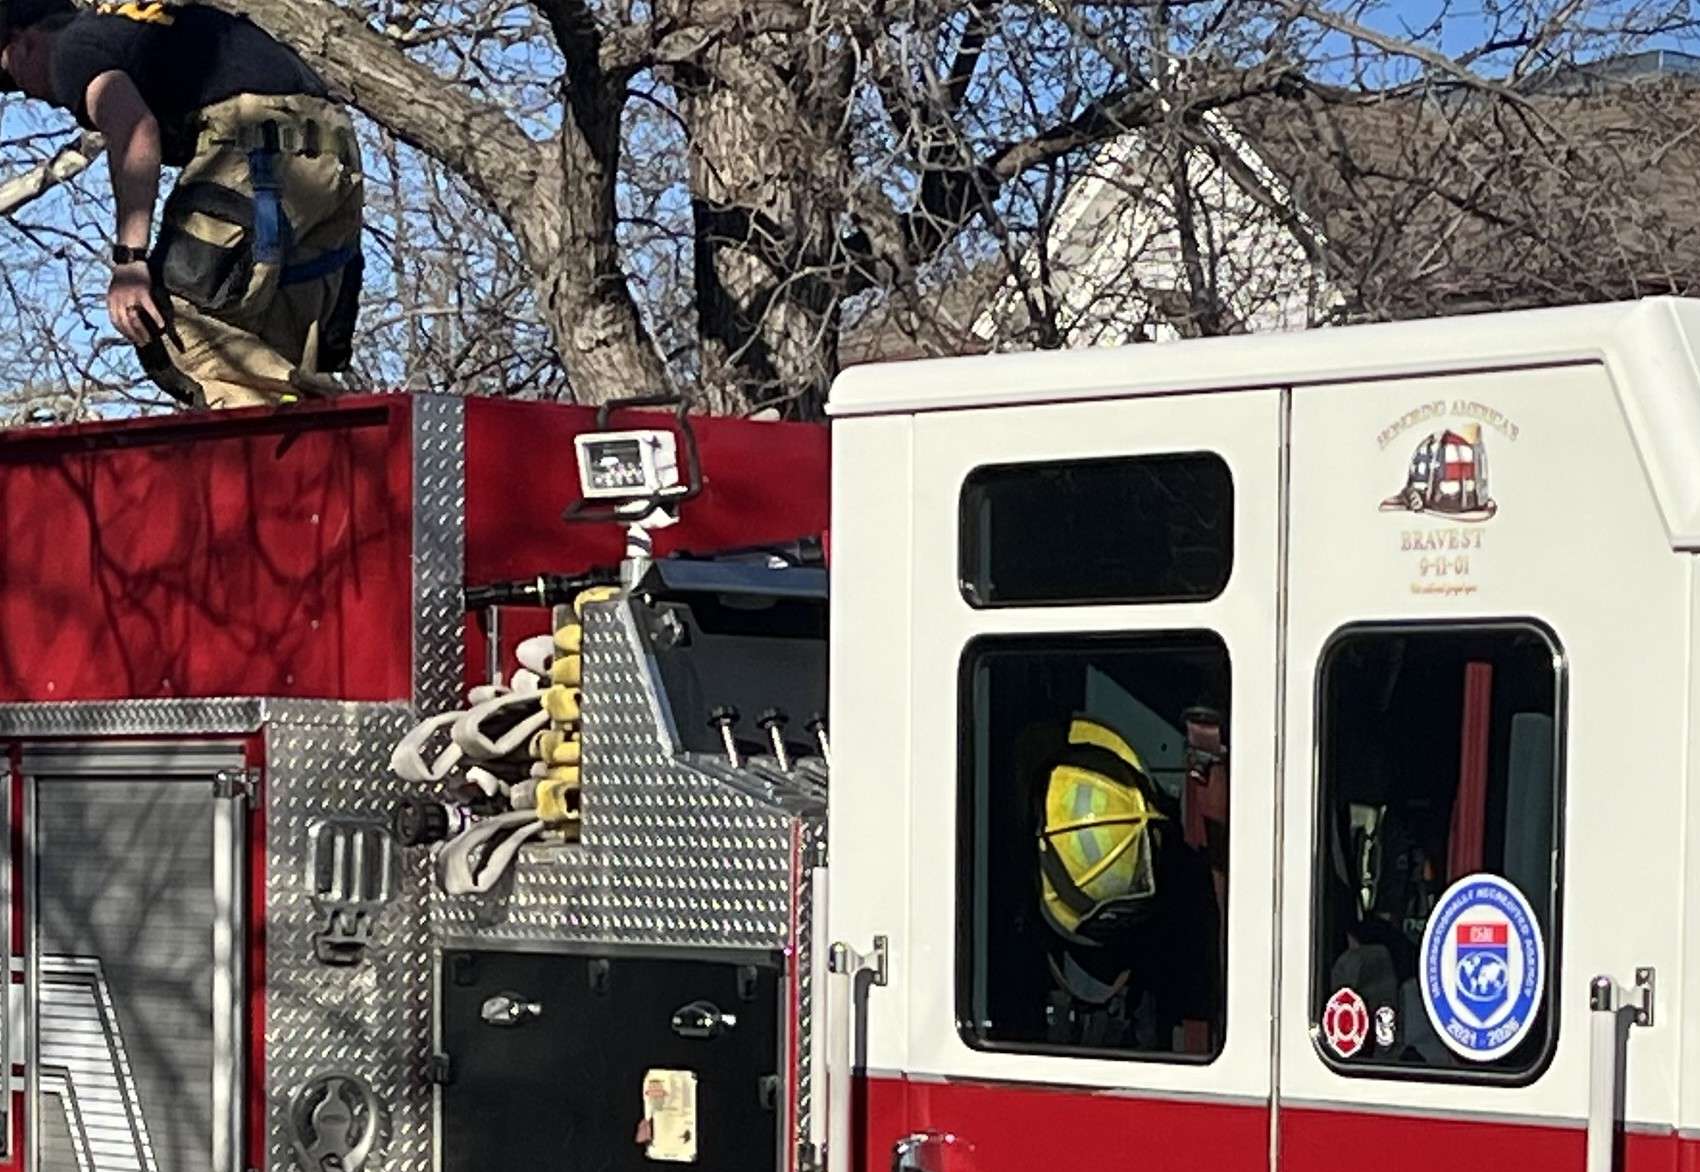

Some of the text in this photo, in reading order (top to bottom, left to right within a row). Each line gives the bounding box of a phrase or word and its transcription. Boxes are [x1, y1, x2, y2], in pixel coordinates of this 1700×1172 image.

[1400, 528, 1486, 551] BRAVEST
[1420, 555, 1470, 577] 9-11-01
[1446, 1017, 1478, 1049] 2021
